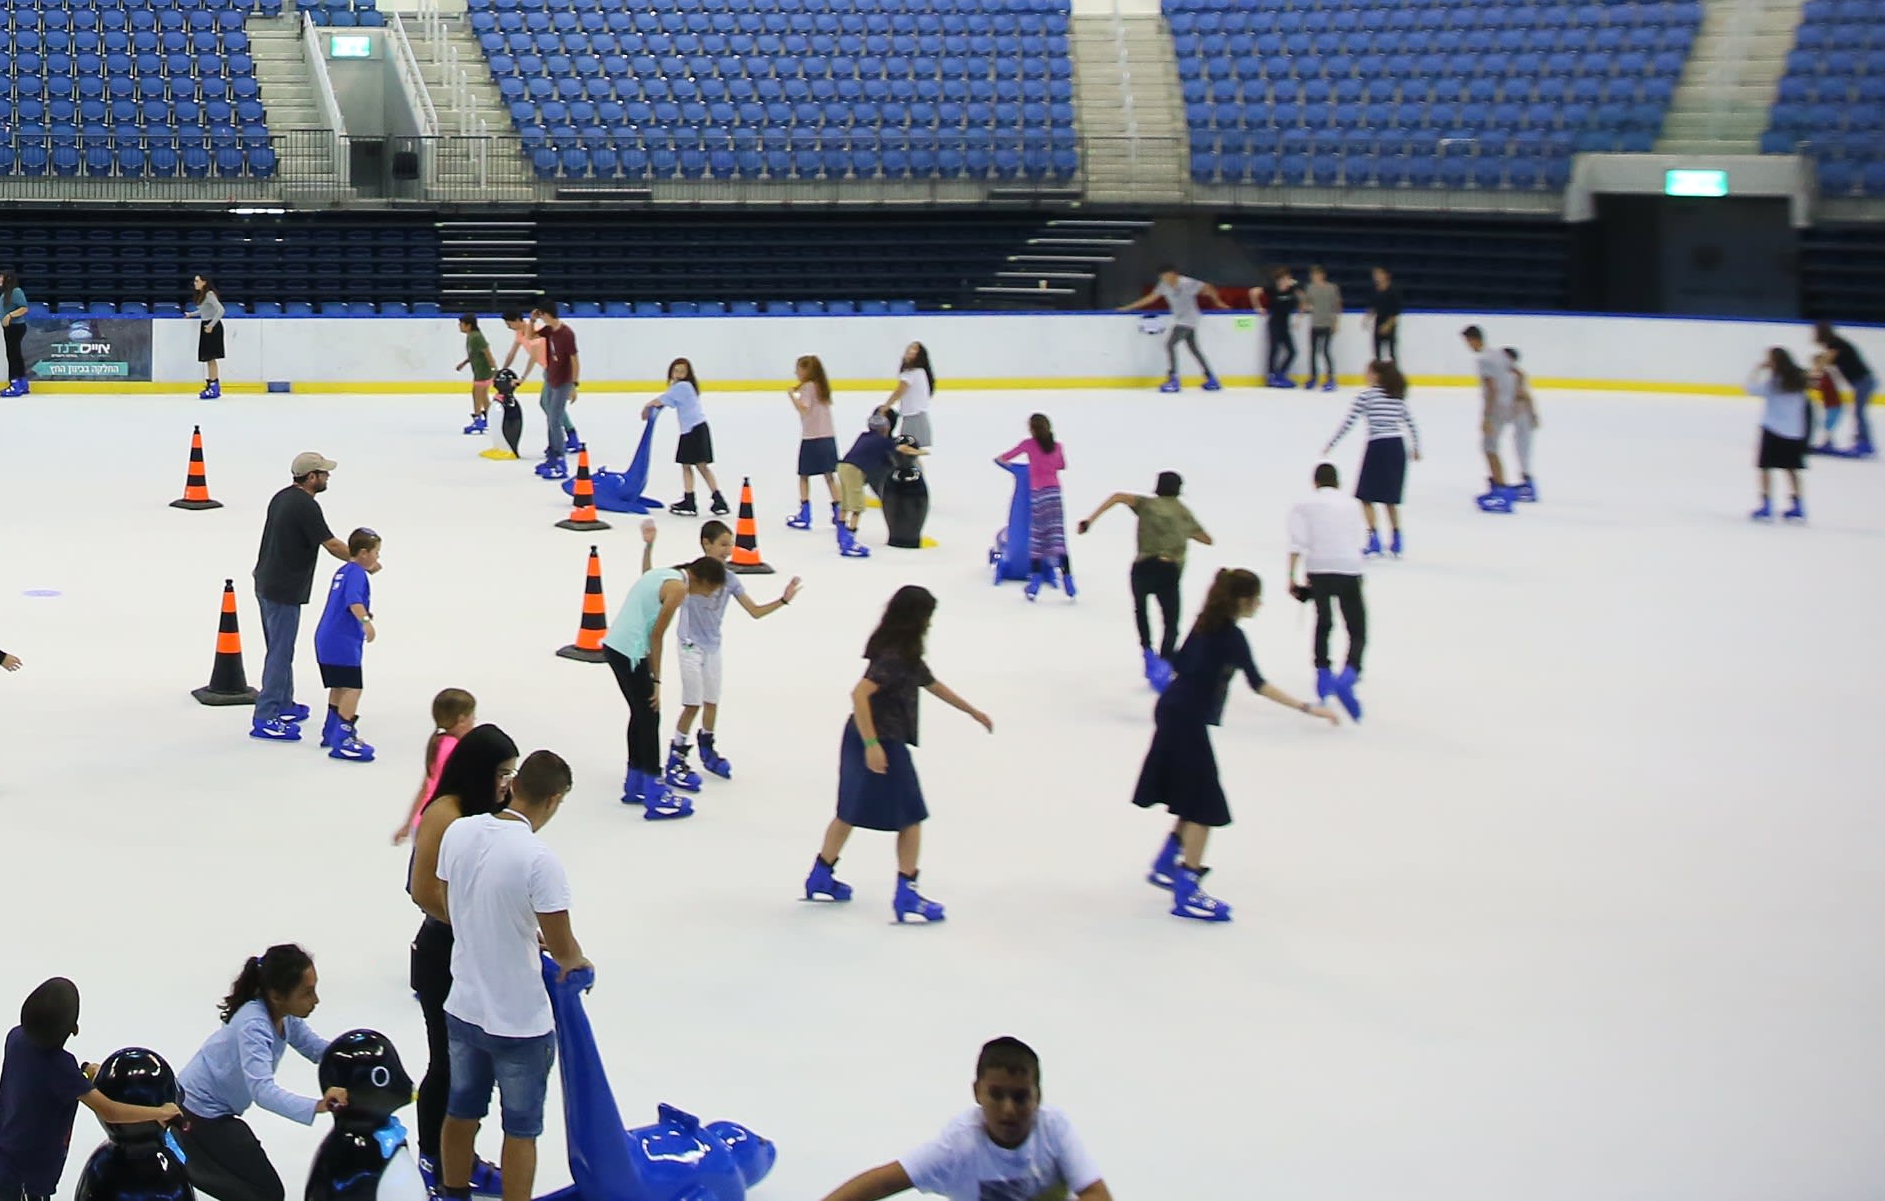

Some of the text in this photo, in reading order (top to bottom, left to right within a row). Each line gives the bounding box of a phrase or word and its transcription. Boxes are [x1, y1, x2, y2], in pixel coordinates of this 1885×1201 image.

[51, 341, 110, 354] אייסלנד
[50, 364, 119, 375] החלקה בכיוון החץ
